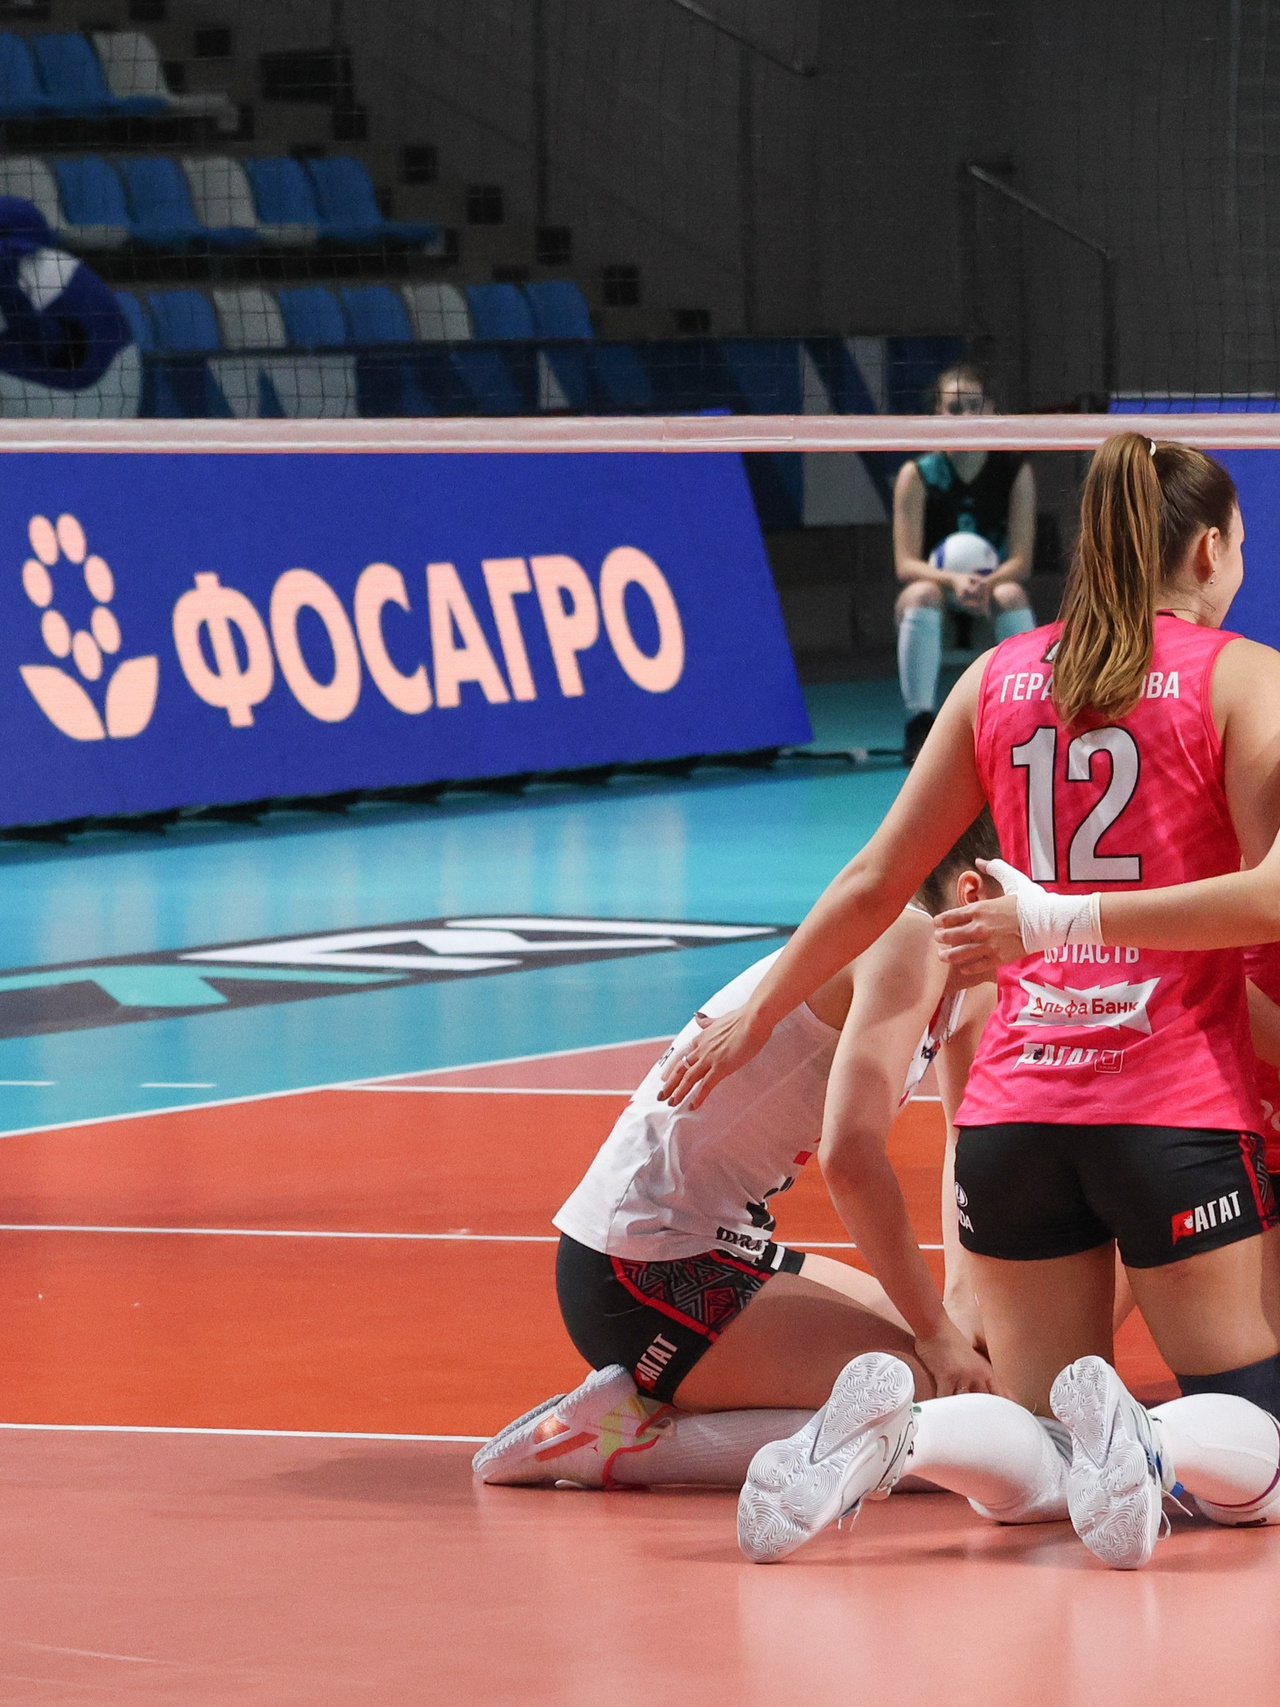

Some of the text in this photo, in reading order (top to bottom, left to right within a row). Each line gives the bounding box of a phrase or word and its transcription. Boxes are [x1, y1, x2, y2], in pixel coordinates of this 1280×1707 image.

[172, 545, 685, 727] ФОСАГРО
[1011, 725, 1142, 883] 12
[1092, 999, 1138, 1015] Банк
[1194, 1190, 1240, 1233] АГАТ
